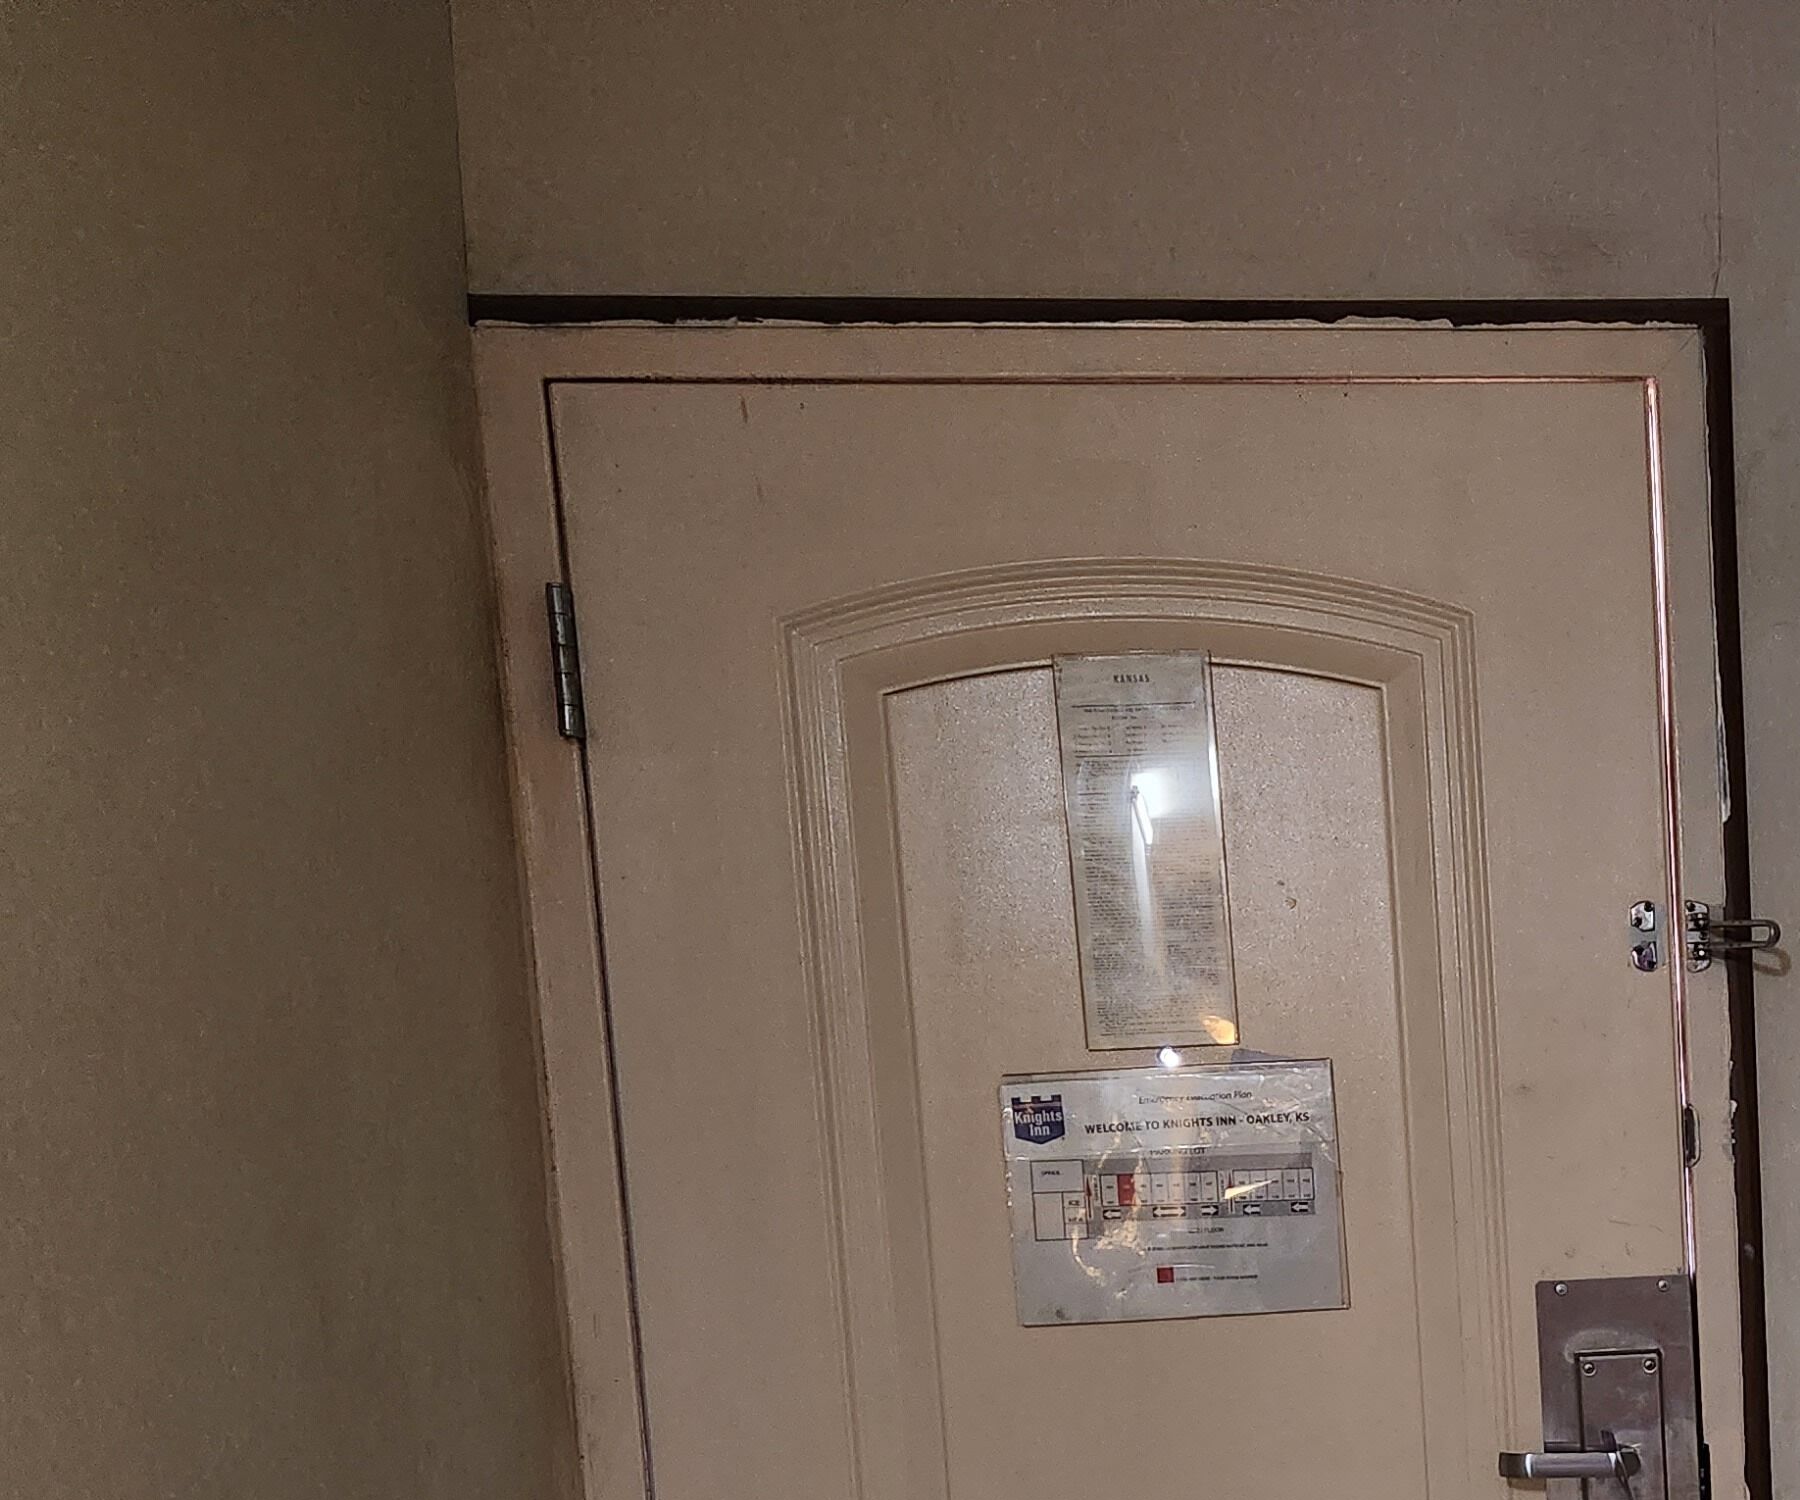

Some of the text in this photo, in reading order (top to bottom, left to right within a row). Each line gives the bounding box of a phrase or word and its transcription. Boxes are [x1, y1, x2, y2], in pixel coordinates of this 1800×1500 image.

[1113, 674, 1150, 683] KANSAS
[1014, 1110, 1063, 1125] Knights
[1145, 1120, 1160, 1131] TO
[1163, 1116, 1214, 1129] KNIGHTS
[1216, 1116, 1237, 1127] INN
[1246, 1113, 1294, 1126] OAKLEY,
[1295, 1111, 1311, 1122] KS
[1029, 1124, 1050, 1137] Inn
